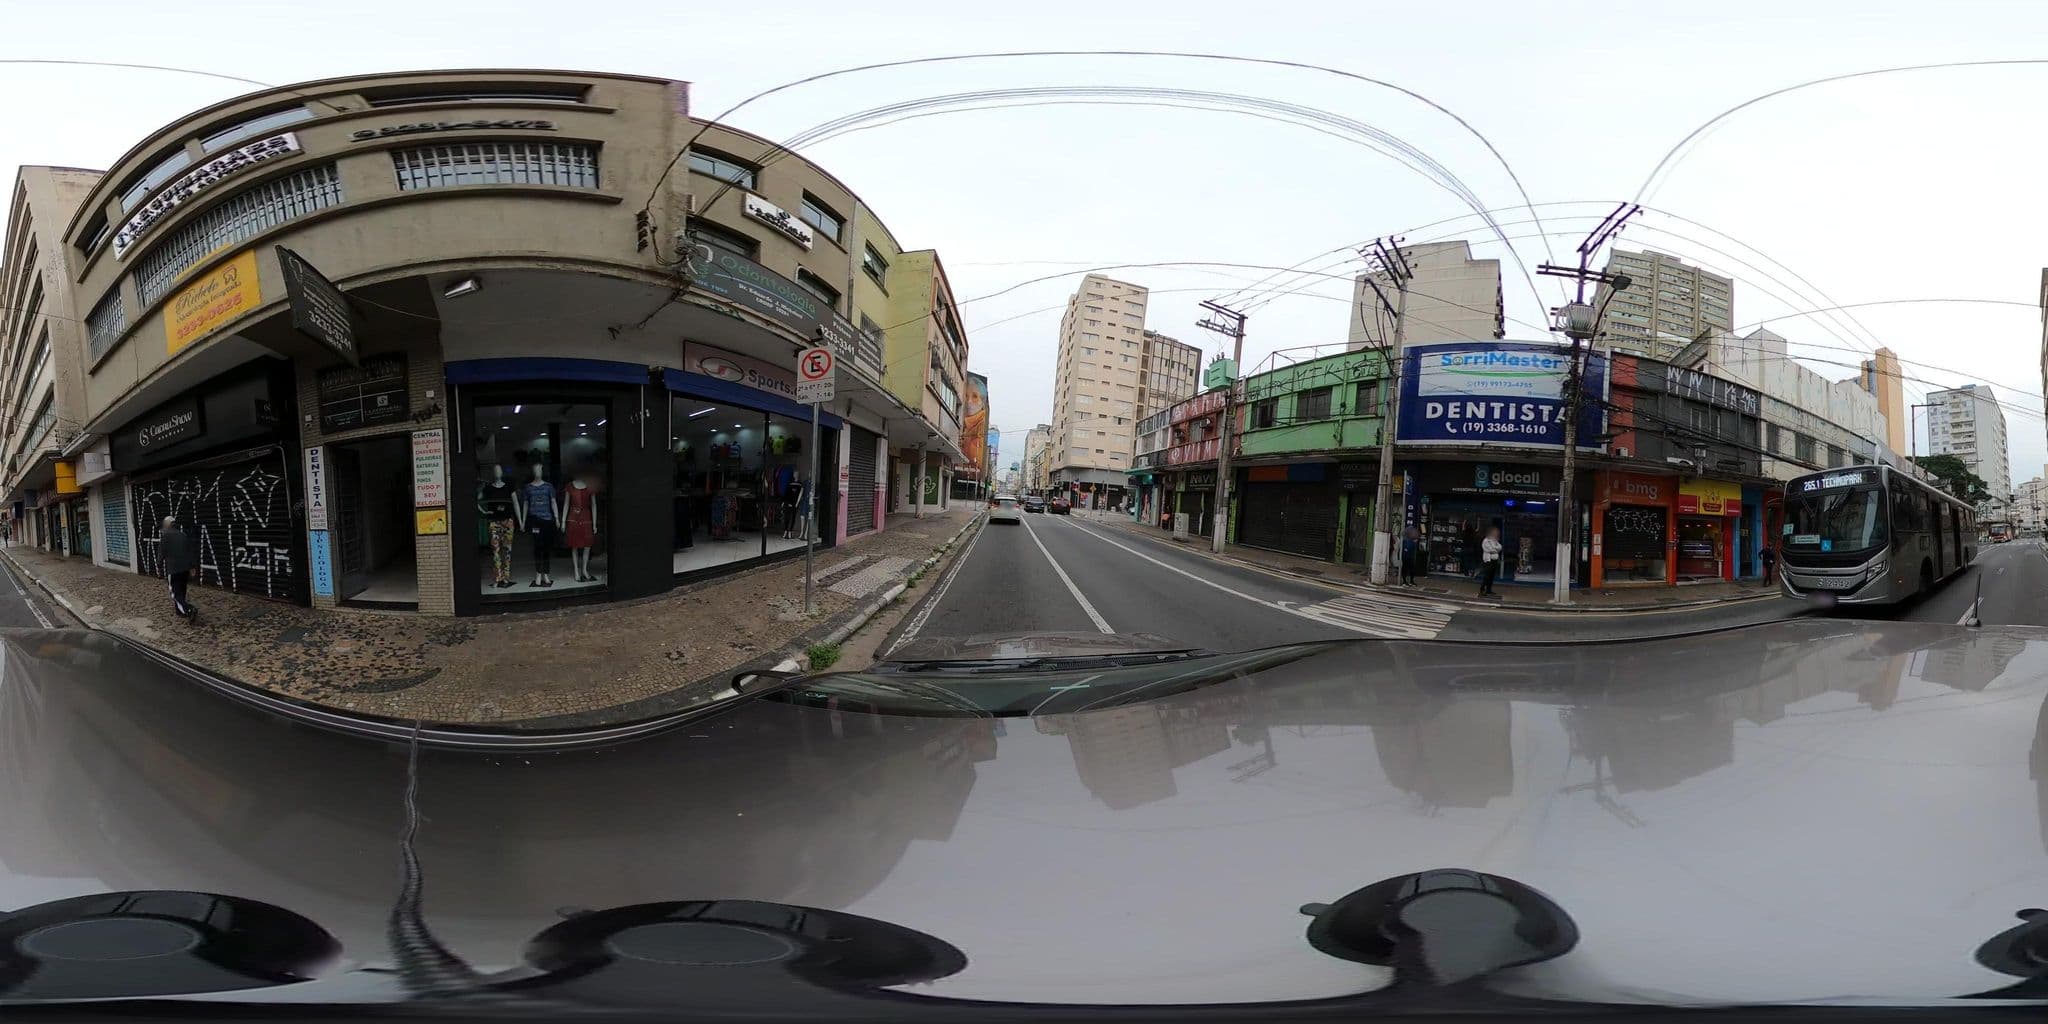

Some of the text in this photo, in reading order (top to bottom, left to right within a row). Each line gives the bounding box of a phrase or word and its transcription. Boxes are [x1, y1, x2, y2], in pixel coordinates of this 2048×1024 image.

[1440, 352, 1563, 369] SorriMaster
[413, 431, 441, 439] CENTRAL
[1463, 422, 1547, 434] (19) 3368-1610
[310, 449, 322, 507] DENTISTA
[1492, 470, 1540, 485] glocall
[1626, 479, 1658, 500] bmg
